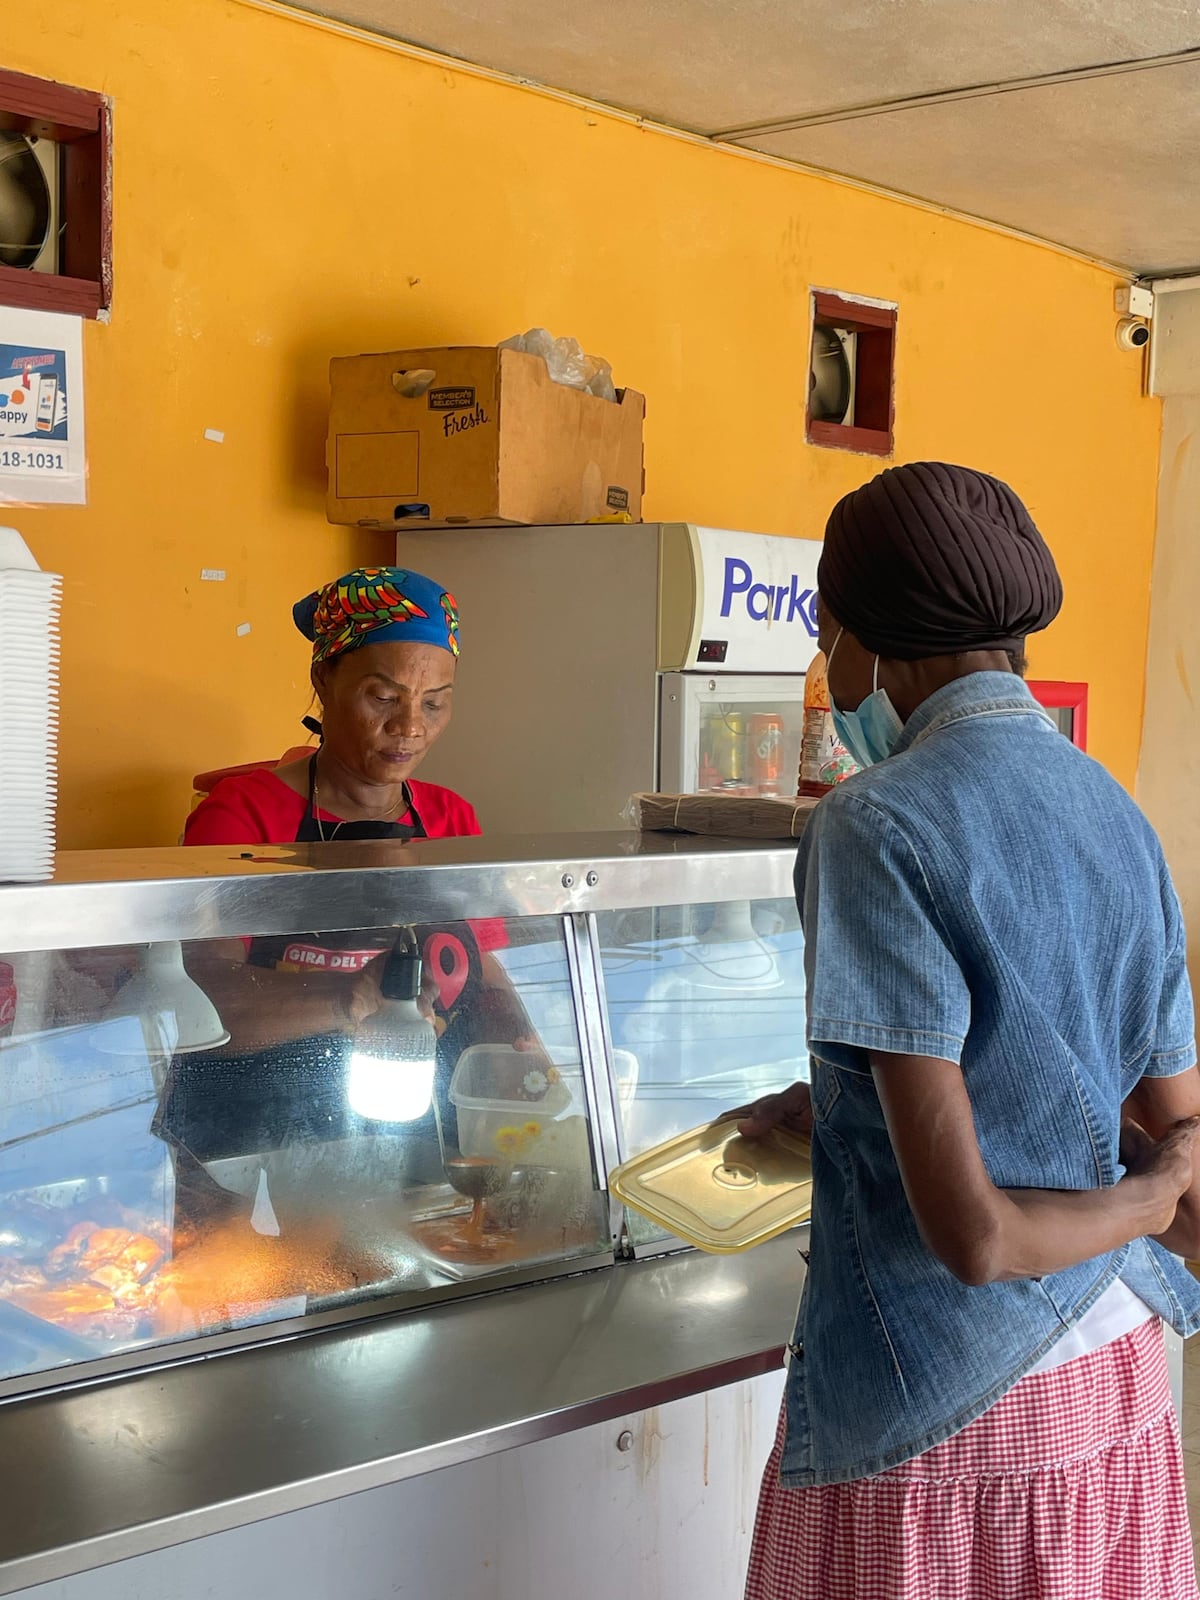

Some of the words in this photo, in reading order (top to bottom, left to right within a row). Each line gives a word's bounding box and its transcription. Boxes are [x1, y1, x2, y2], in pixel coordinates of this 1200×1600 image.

[442, 402, 488, 437] Fresh
[288, 949, 326, 966] GIRA
[329, 956, 357, 968] DEL
